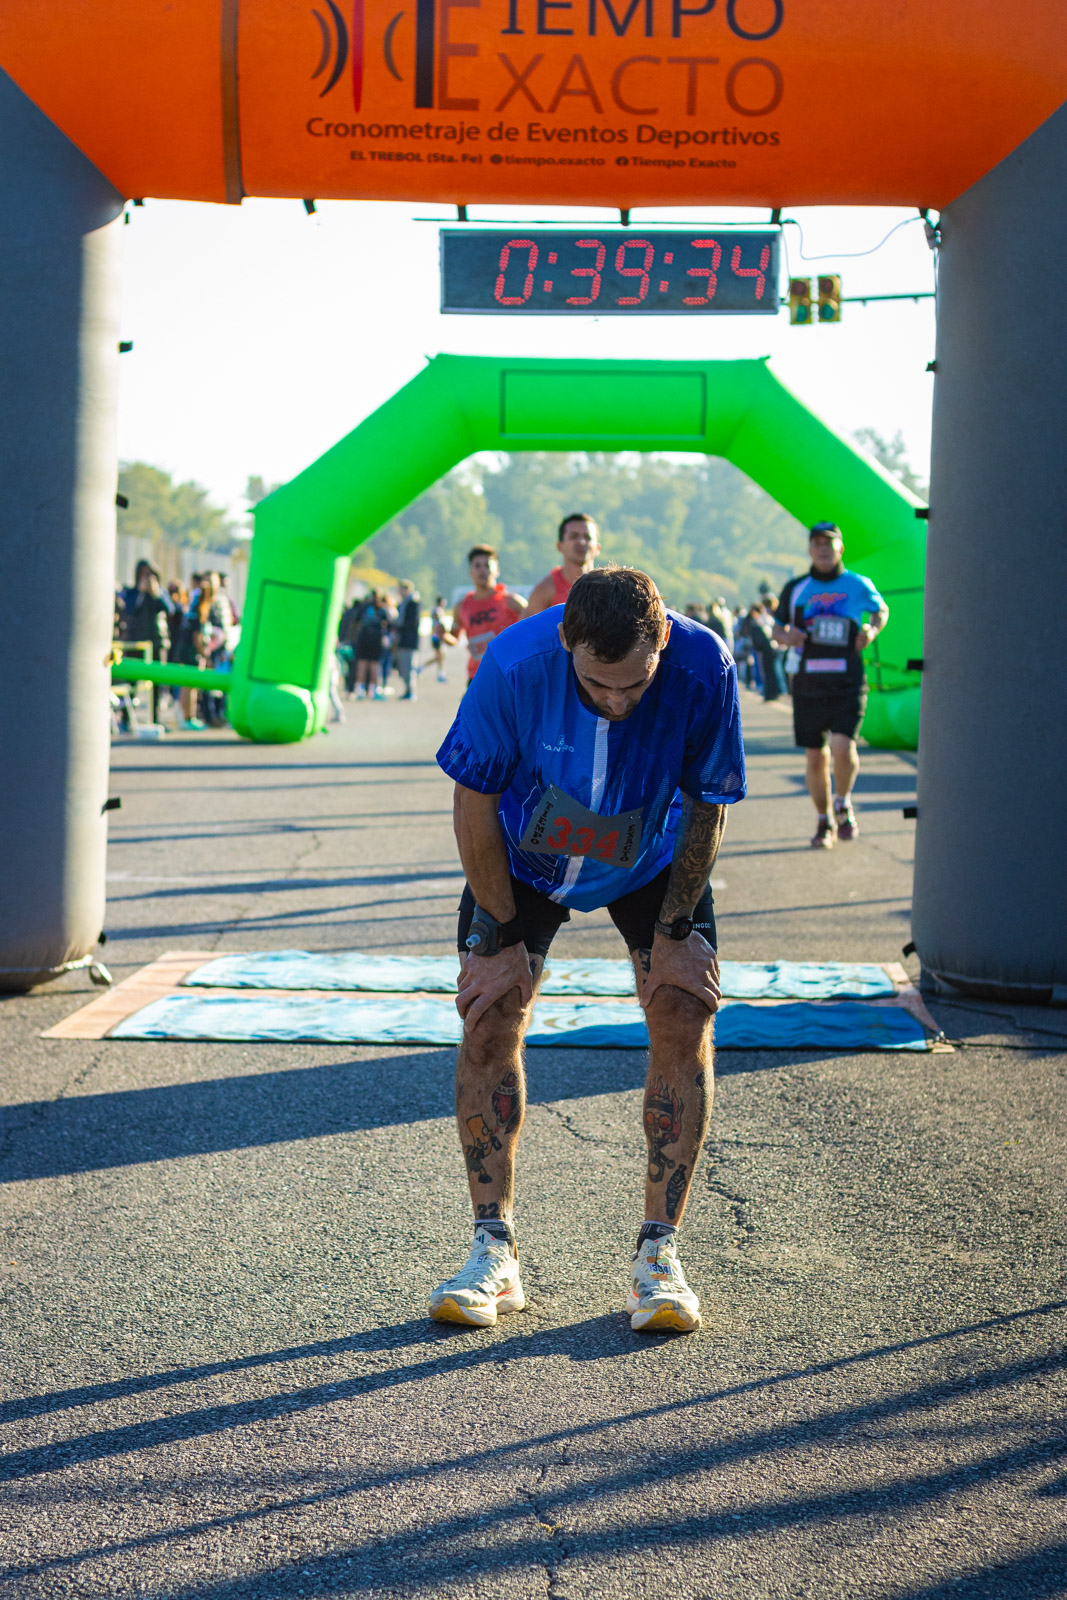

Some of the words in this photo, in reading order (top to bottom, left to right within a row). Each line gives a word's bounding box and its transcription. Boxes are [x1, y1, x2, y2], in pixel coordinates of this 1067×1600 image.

[306, 117, 481, 145] Cronometraje
[487, 121, 520, 141] de
[527, 122, 629, 143] Eventos
[637, 124, 781, 149] Deportivos
[350, 151, 366, 161] EL
[369, 151, 423, 163] TREBOL
[461, 154, 482, 165] Fe)
[631, 156, 685, 169] Tiempo
[689, 157, 736, 168] Exacto
[530, 800, 554, 845] TIEMPO
[547, 816, 620, 858] 334
[477, 1202, 500, 1219] 22
